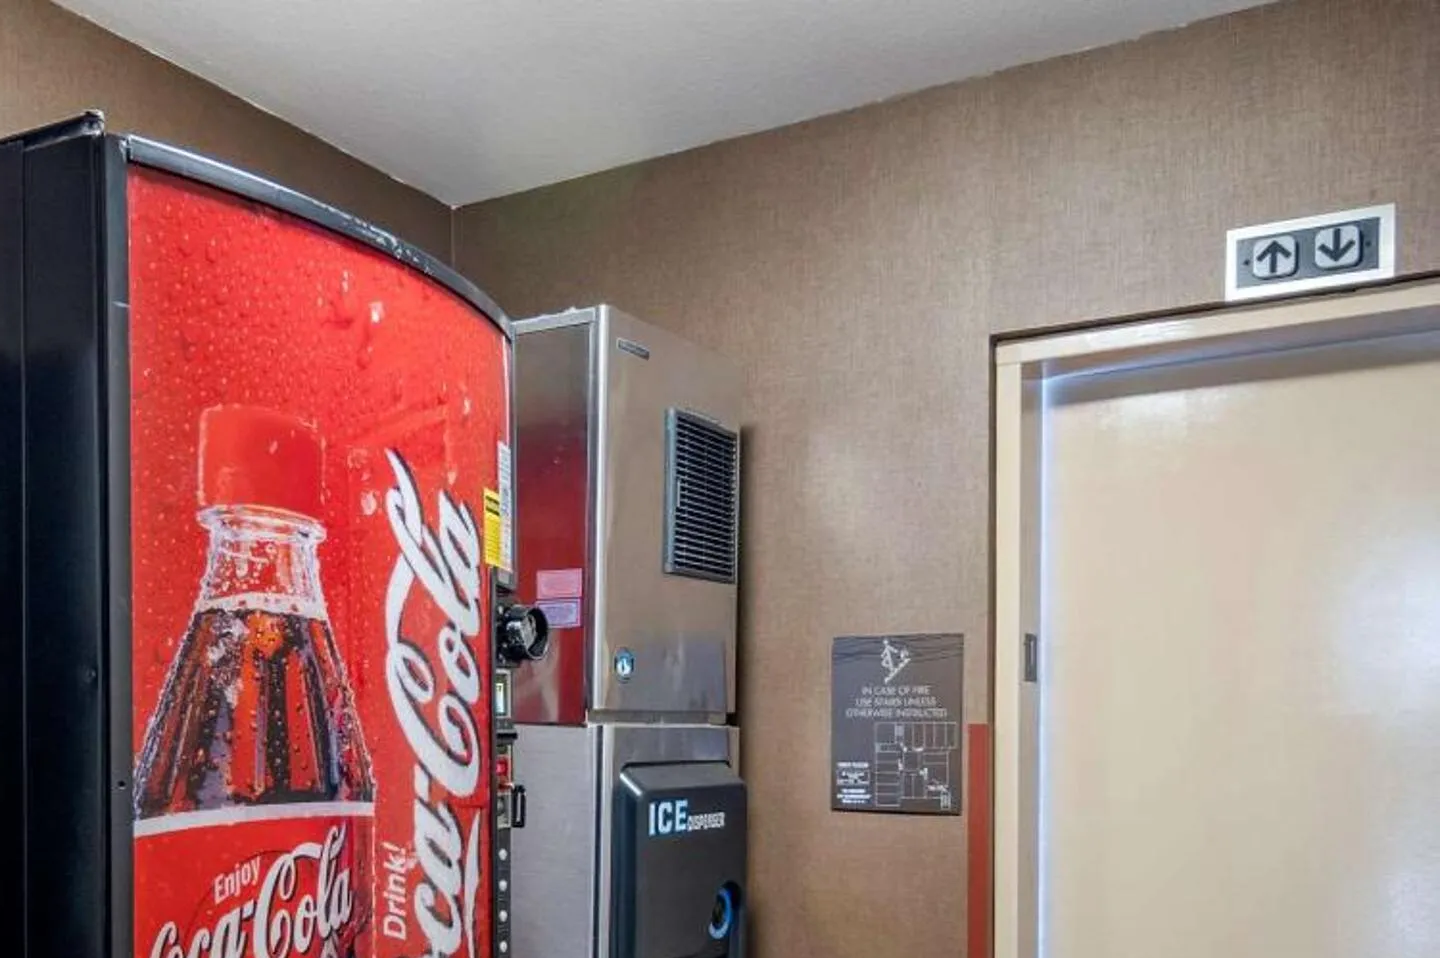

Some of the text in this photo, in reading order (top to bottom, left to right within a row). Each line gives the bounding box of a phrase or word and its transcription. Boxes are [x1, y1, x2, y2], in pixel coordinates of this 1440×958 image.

[648, 798, 689, 837] ICE
[213, 855, 262, 906] Enjoy
[382, 841, 409, 941] Drink!
